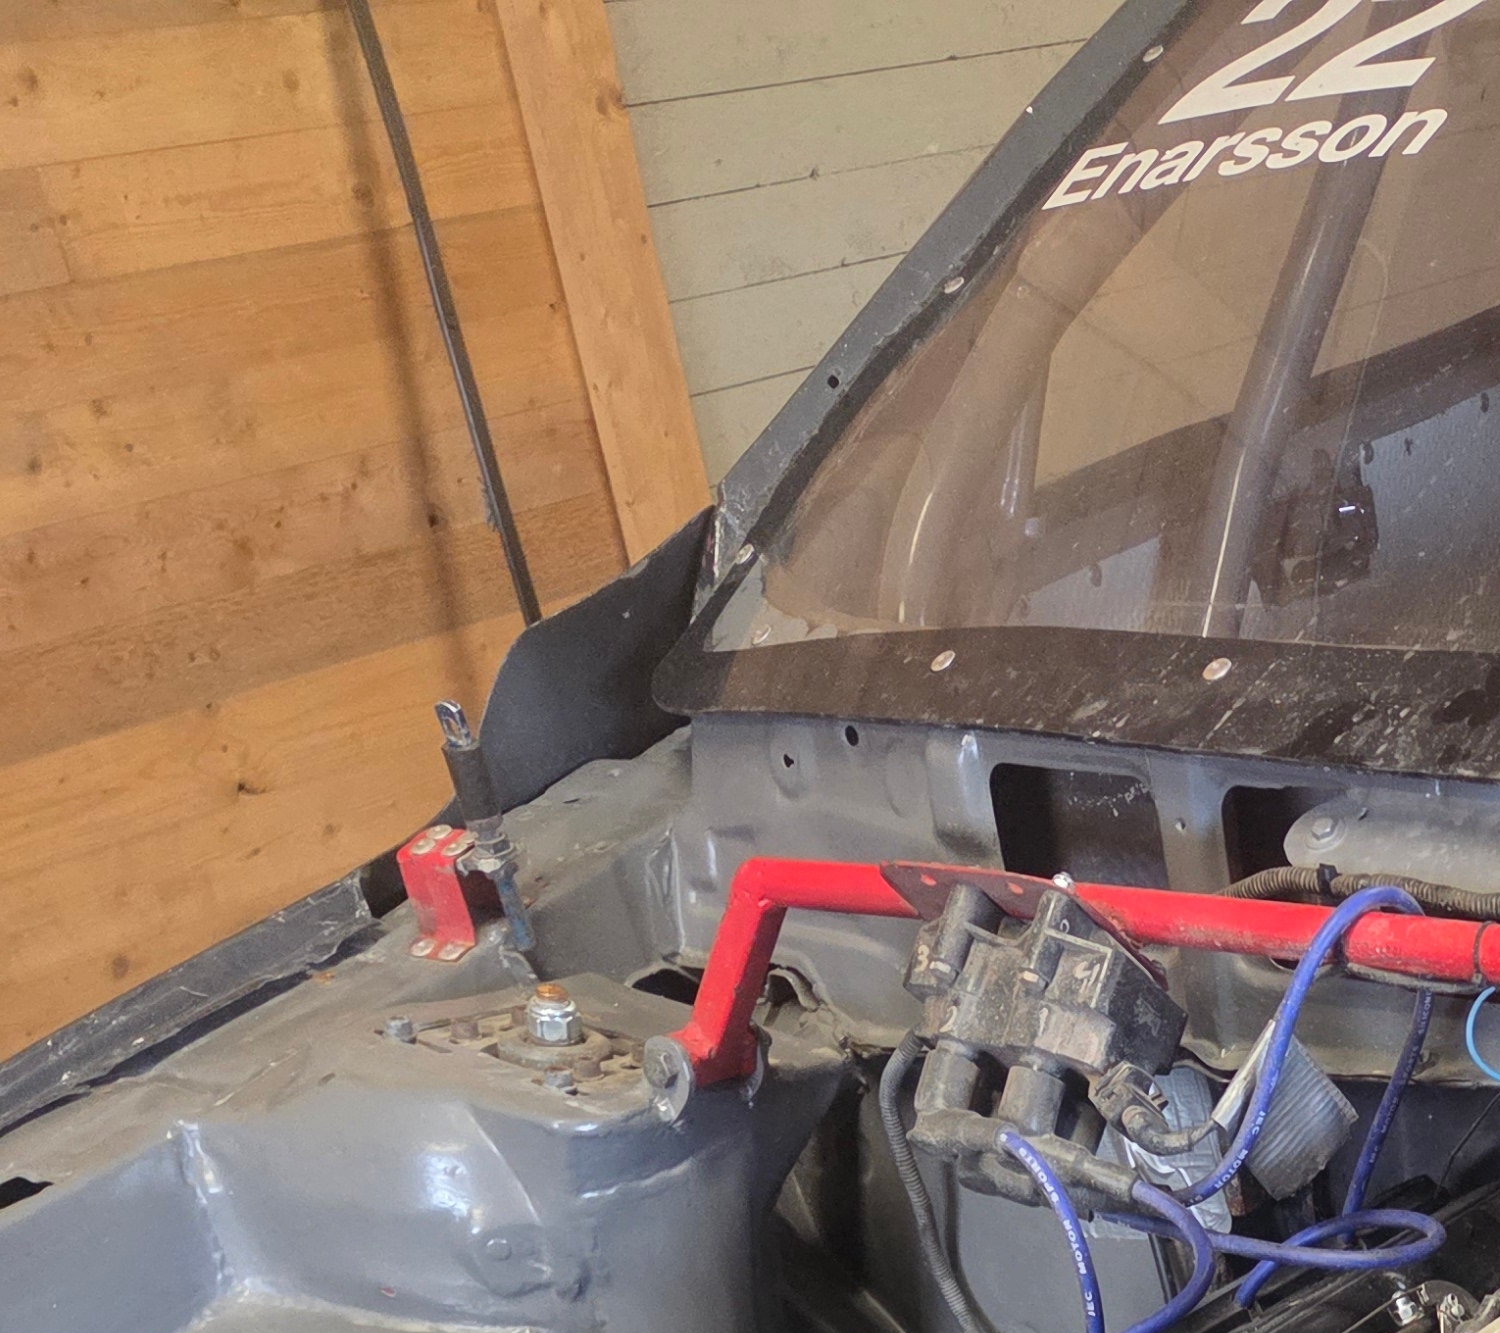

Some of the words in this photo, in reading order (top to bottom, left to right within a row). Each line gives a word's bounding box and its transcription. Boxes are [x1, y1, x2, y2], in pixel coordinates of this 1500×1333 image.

[1158, 0, 1487, 125] 22
[1042, 107, 1448, 210] Enarsson
[1018, 1146, 1061, 1204] SPORTS
[1214, 1148, 1249, 1189] MOTOR
[1062, 1218, 1088, 1275] MOTOR
